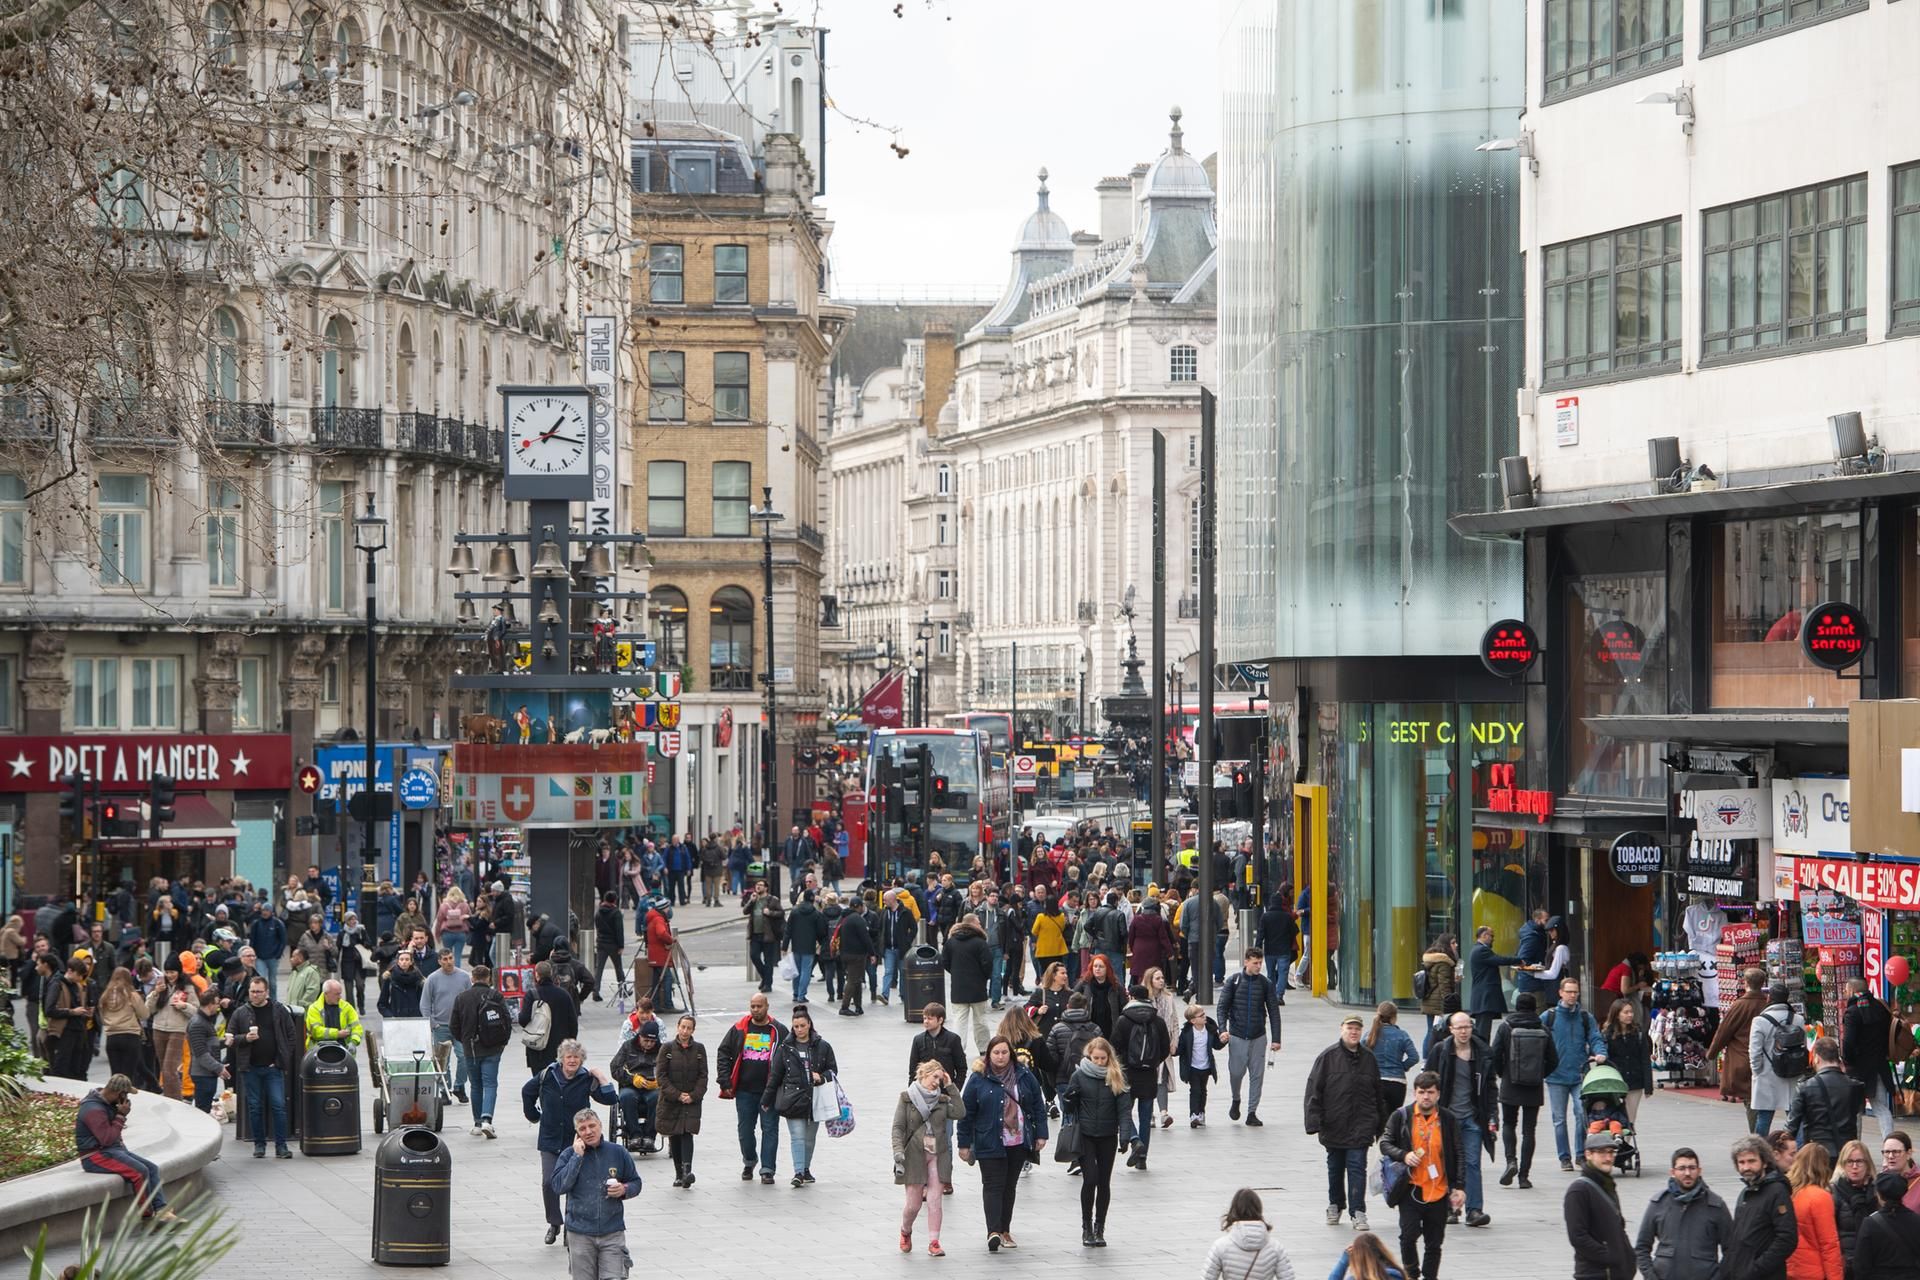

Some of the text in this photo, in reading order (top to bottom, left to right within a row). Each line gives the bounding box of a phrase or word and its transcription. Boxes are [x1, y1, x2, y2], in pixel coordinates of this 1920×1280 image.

[591, 323, 610, 371] THE
[595, 464, 610, 499] OF
[49, 744, 220, 782] PRET A MANGER
[400, 771, 434, 796] CHANGE
[1822, 793, 1850, 822] Cre
[1616, 846, 1661, 864] TOBACCO
[1689, 830, 1698, 859] &
[1616, 864, 1660, 872] SOLD HERE
[1688, 875, 1743, 897] STUDENT DISCOUNT
[1822, 863, 1876, 903] SALE
[1877, 867, 1897, 897] 50%
